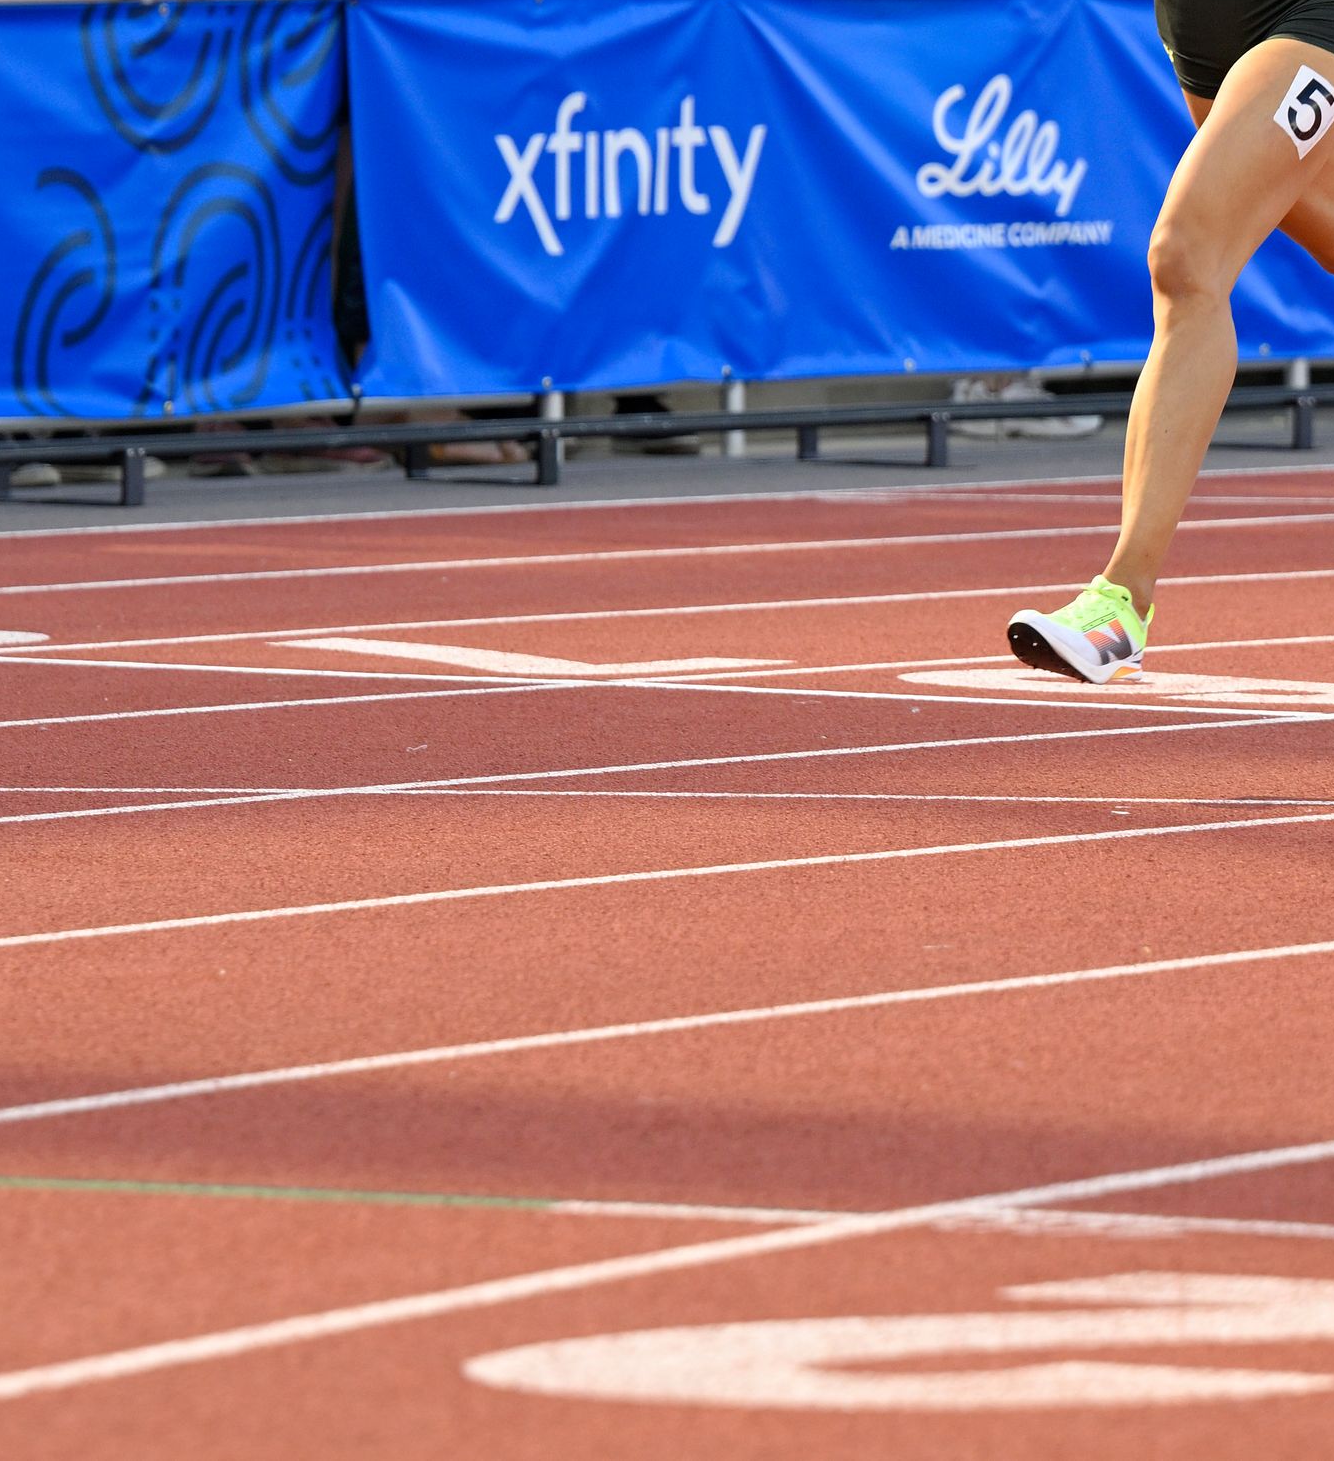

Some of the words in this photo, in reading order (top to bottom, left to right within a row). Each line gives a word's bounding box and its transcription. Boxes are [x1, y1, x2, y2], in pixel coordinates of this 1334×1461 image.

[492, 90, 768, 258] xfinity
[915, 72, 1089, 218] Lilly
[890, 225, 911, 251] A
[911, 223, 1008, 250] MEDICINE
[1007, 219, 1115, 247] COMPANY
